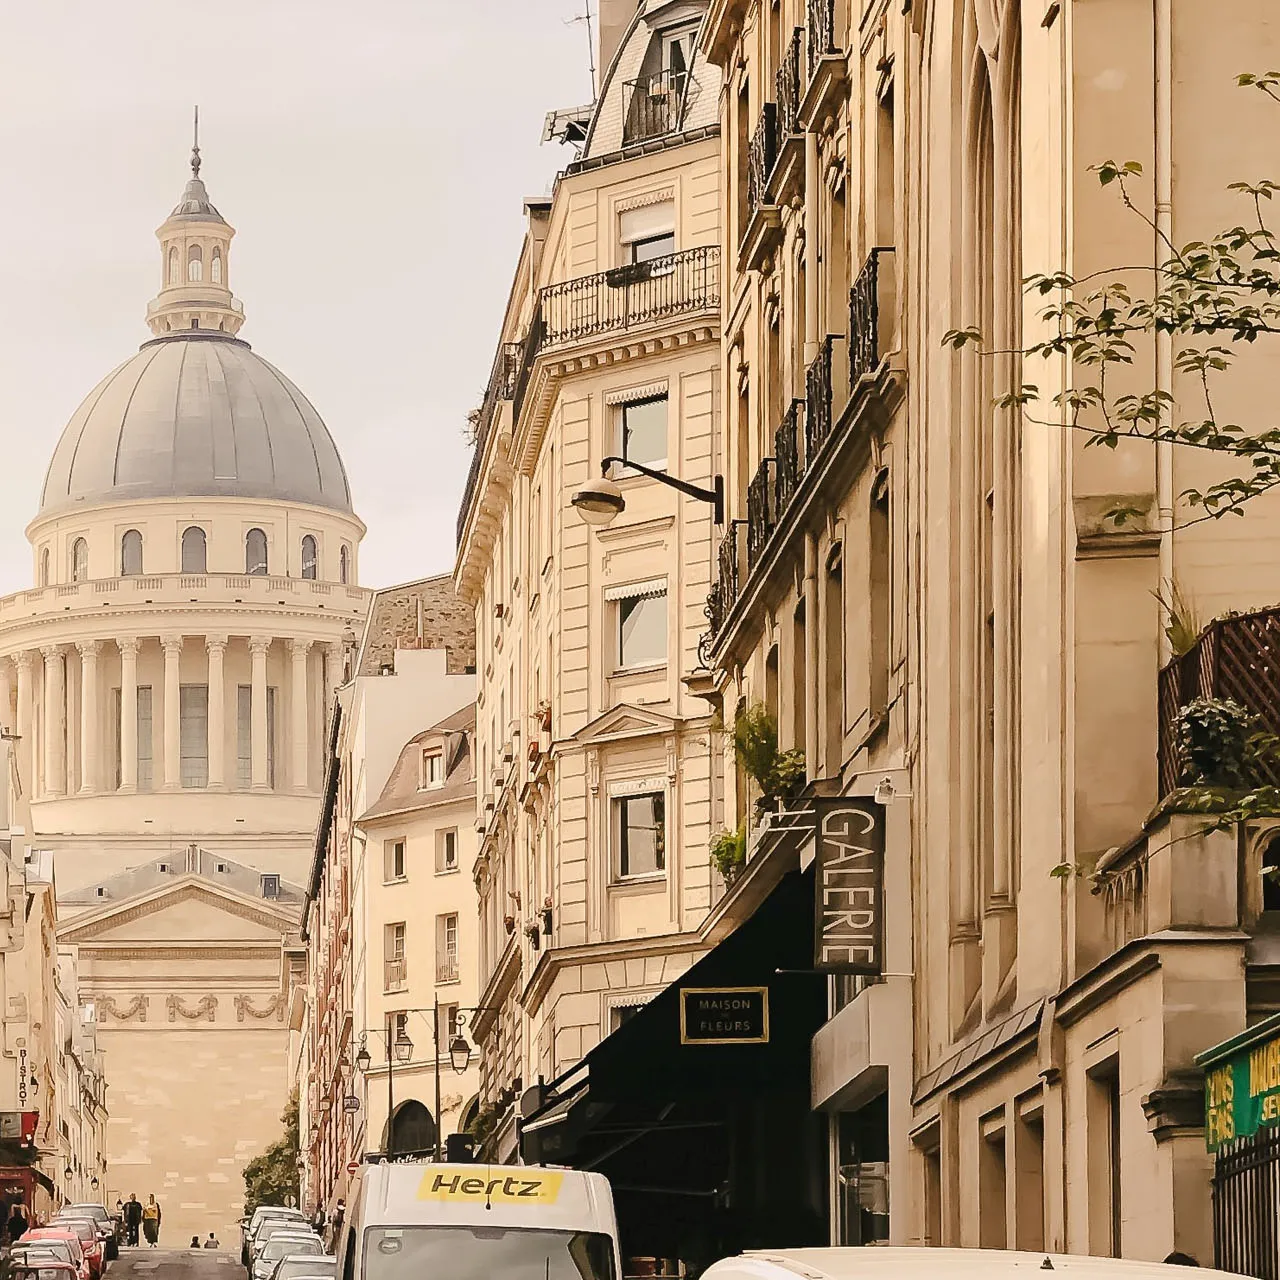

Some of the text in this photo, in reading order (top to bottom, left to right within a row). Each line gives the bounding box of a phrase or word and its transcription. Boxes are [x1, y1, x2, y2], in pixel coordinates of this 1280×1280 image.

[821, 808, 875, 963] GALERIE
[699, 999, 752, 1011] MAISON
[700, 1020, 752, 1032] FLEURS
[19, 1049, 27, 1108] BISTROT
[431, 1174, 542, 1197] Hertz
